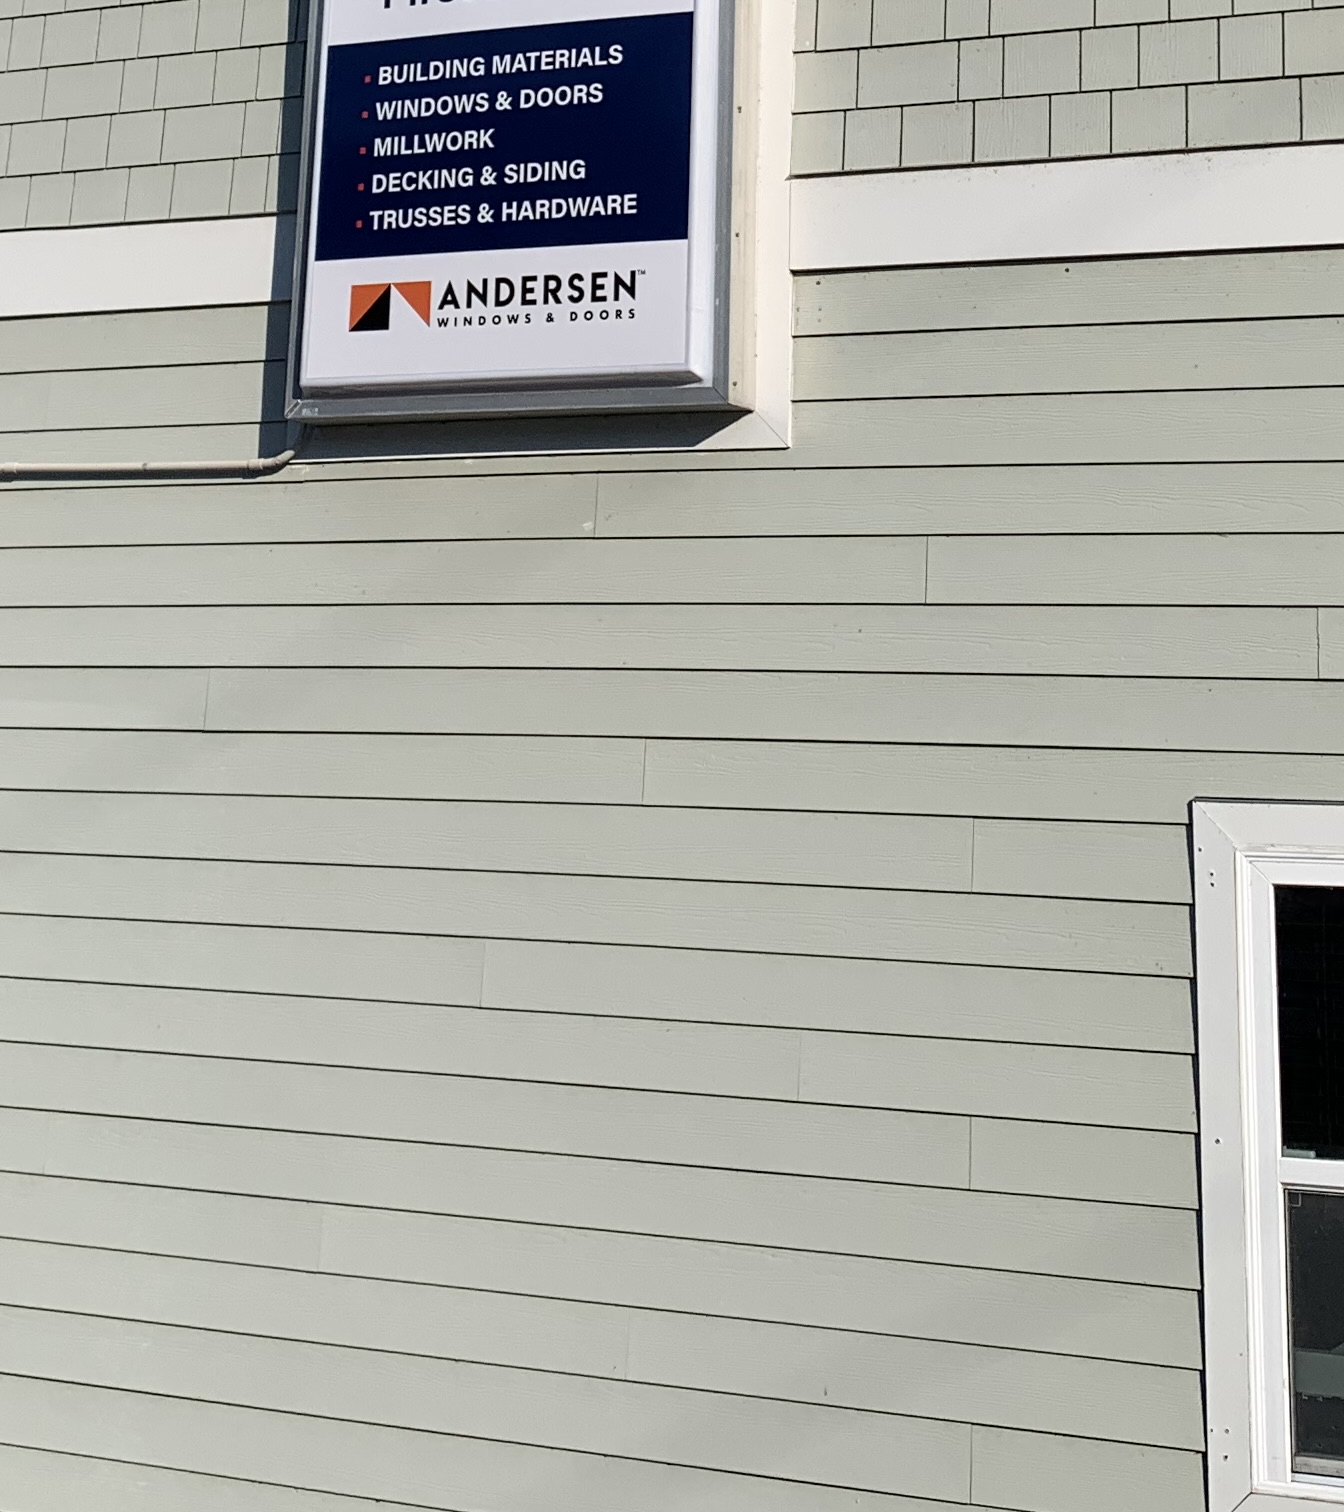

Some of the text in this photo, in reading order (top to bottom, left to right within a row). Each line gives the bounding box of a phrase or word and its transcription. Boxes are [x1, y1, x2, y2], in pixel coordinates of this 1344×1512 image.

[378, 44, 623, 86] BUILDING MATERIALS
[375, 82, 603, 121] WINDOWS & DOORS
[373, 128, 495, 157] MILLWORK
[371, 159, 586, 194] DECKING & SIDING
[369, 193, 638, 231] TRUSSES & HARDWARE
[436, 308, 636, 328] WINDOWS & DOORS
